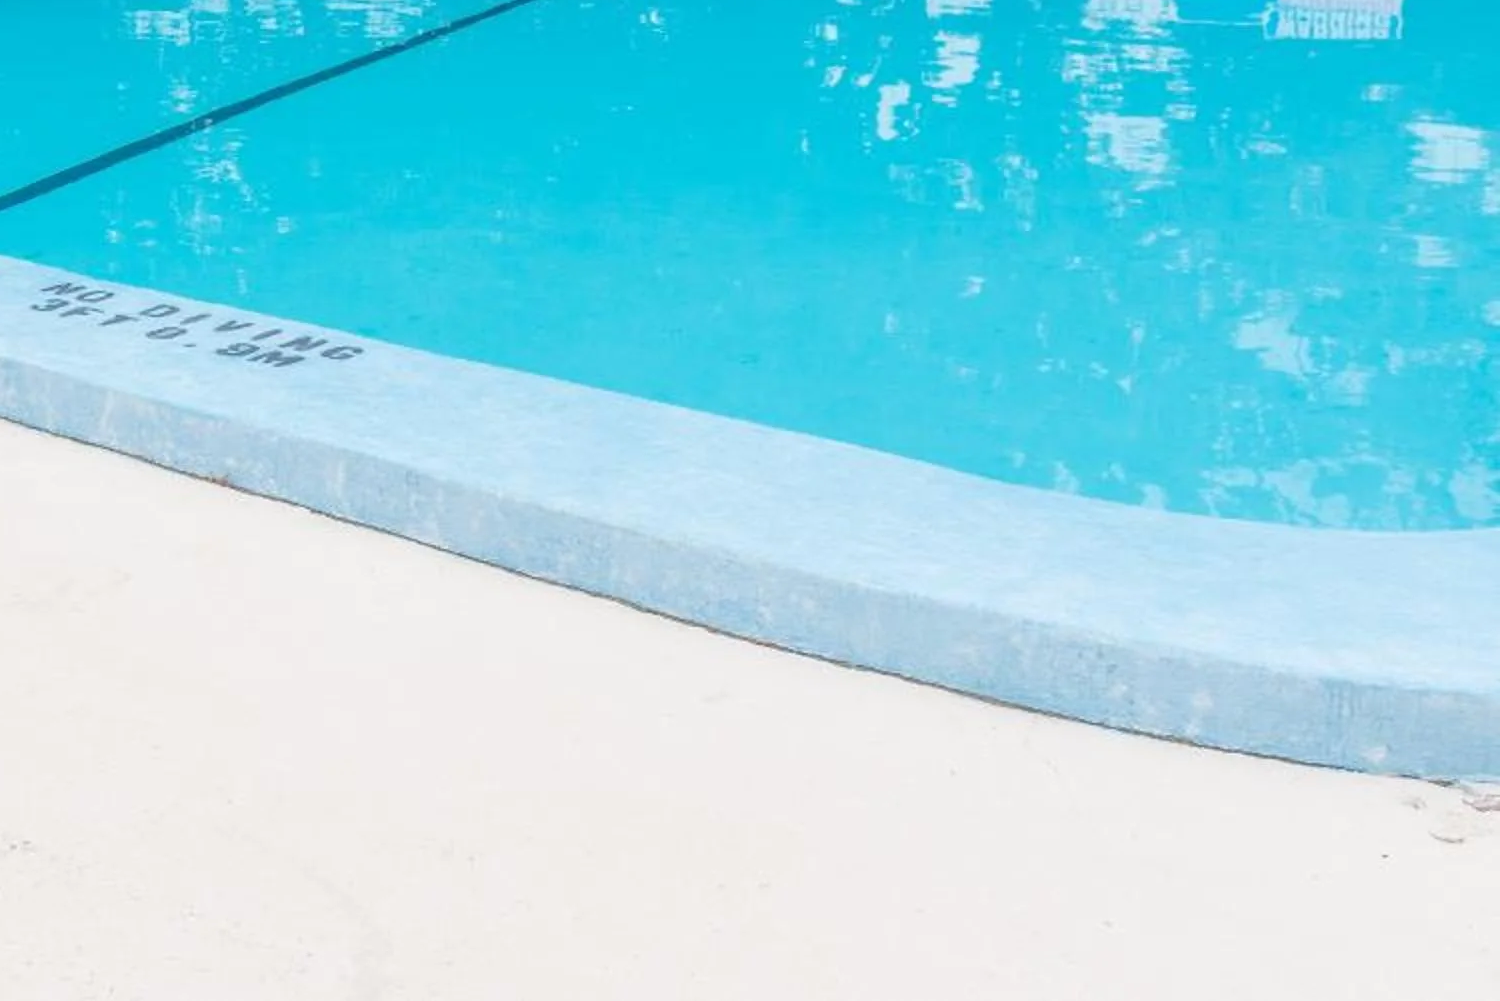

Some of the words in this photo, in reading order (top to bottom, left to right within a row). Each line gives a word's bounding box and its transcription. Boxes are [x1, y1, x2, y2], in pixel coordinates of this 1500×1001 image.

[31, 298, 140, 326] 3FT
[39, 281, 115, 303] NO
[139, 303, 365, 361] DIVING
